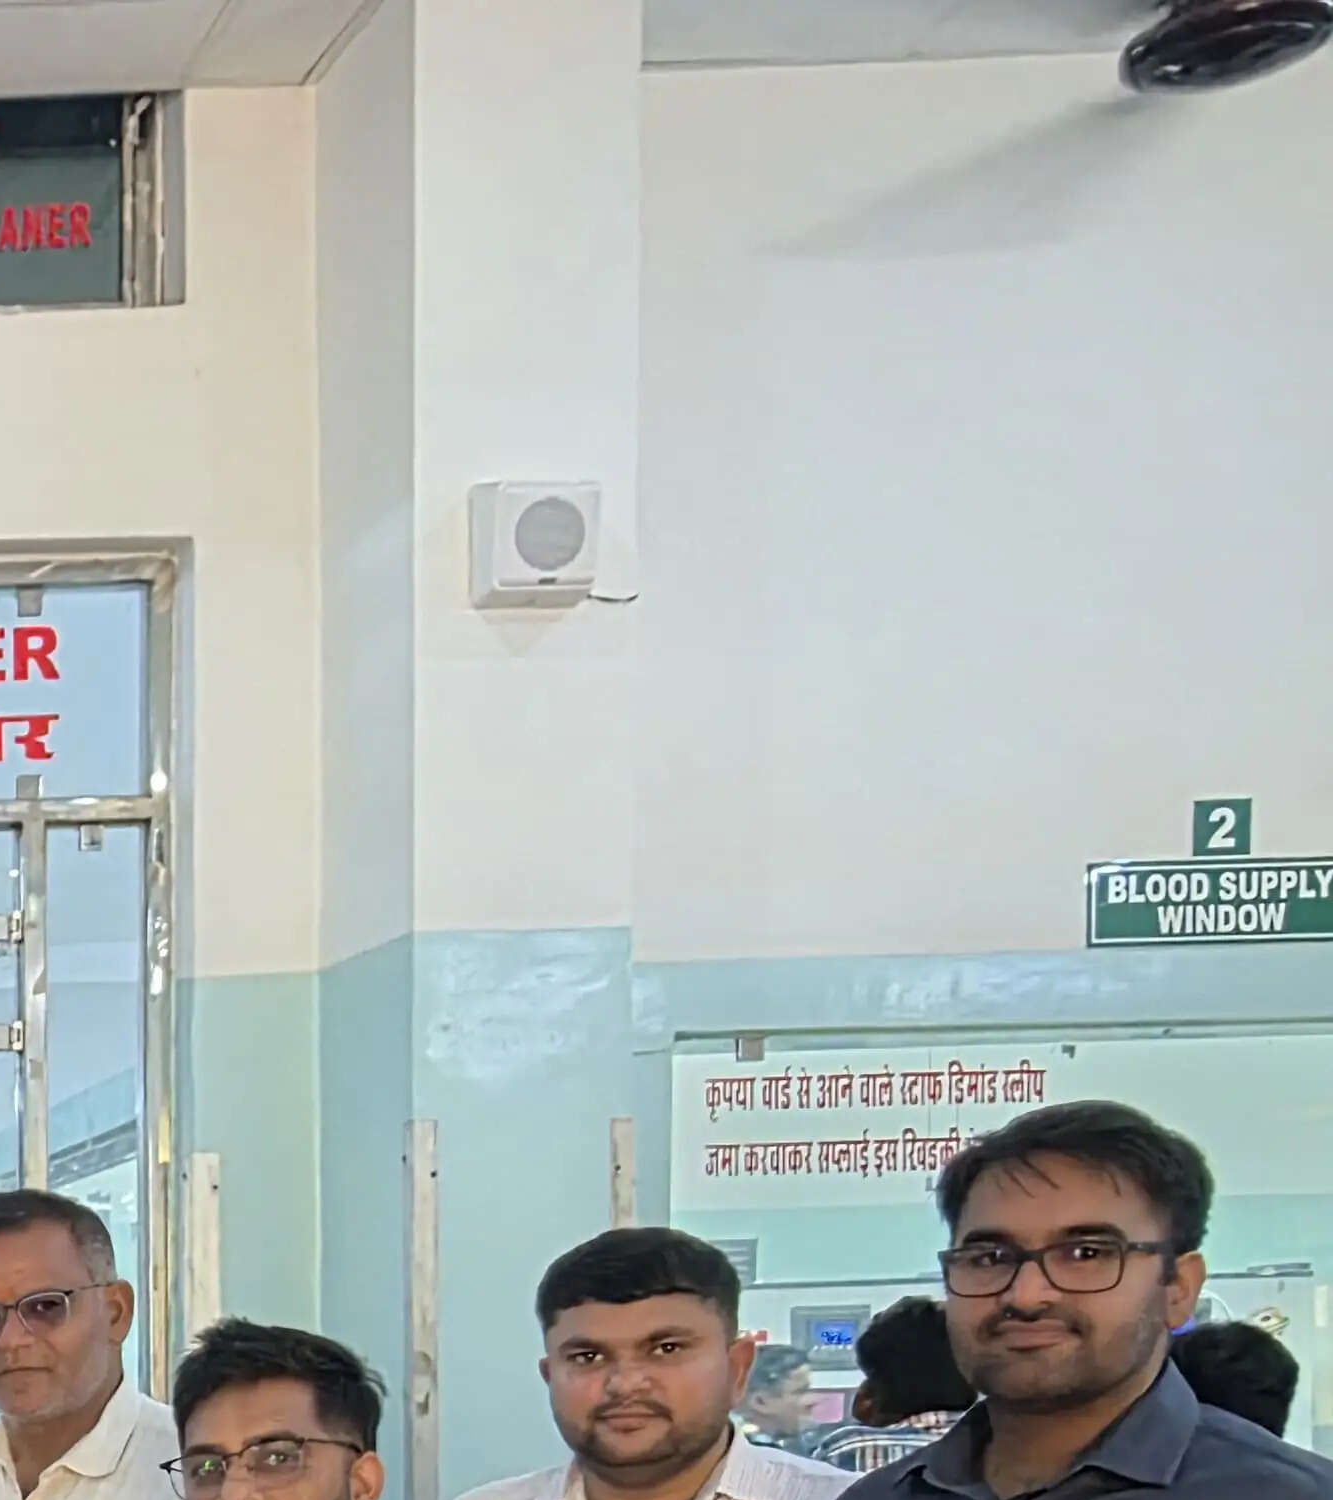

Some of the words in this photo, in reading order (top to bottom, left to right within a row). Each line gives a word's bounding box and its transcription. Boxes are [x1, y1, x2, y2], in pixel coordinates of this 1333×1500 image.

[1207, 807, 1237, 849] 2
[1107, 872, 1209, 904] BLOOD
[1219, 869, 1333, 901] SUPPLY
[1157, 903, 1286, 934] WINDOW
[704, 1077, 756, 1123] कृपया
[761, 1066, 792, 1110] वार्ड
[796, 1067, 811, 1109] से
[816, 1065, 854, 1108] आने
[858, 1064, 895, 1107] वाले
[900, 1071, 944, 1105] स्टाफ
[705, 1144, 739, 1176] जमा
[743, 1142, 813, 1176] करवाकर
[873, 1138, 898, 1177] इस
